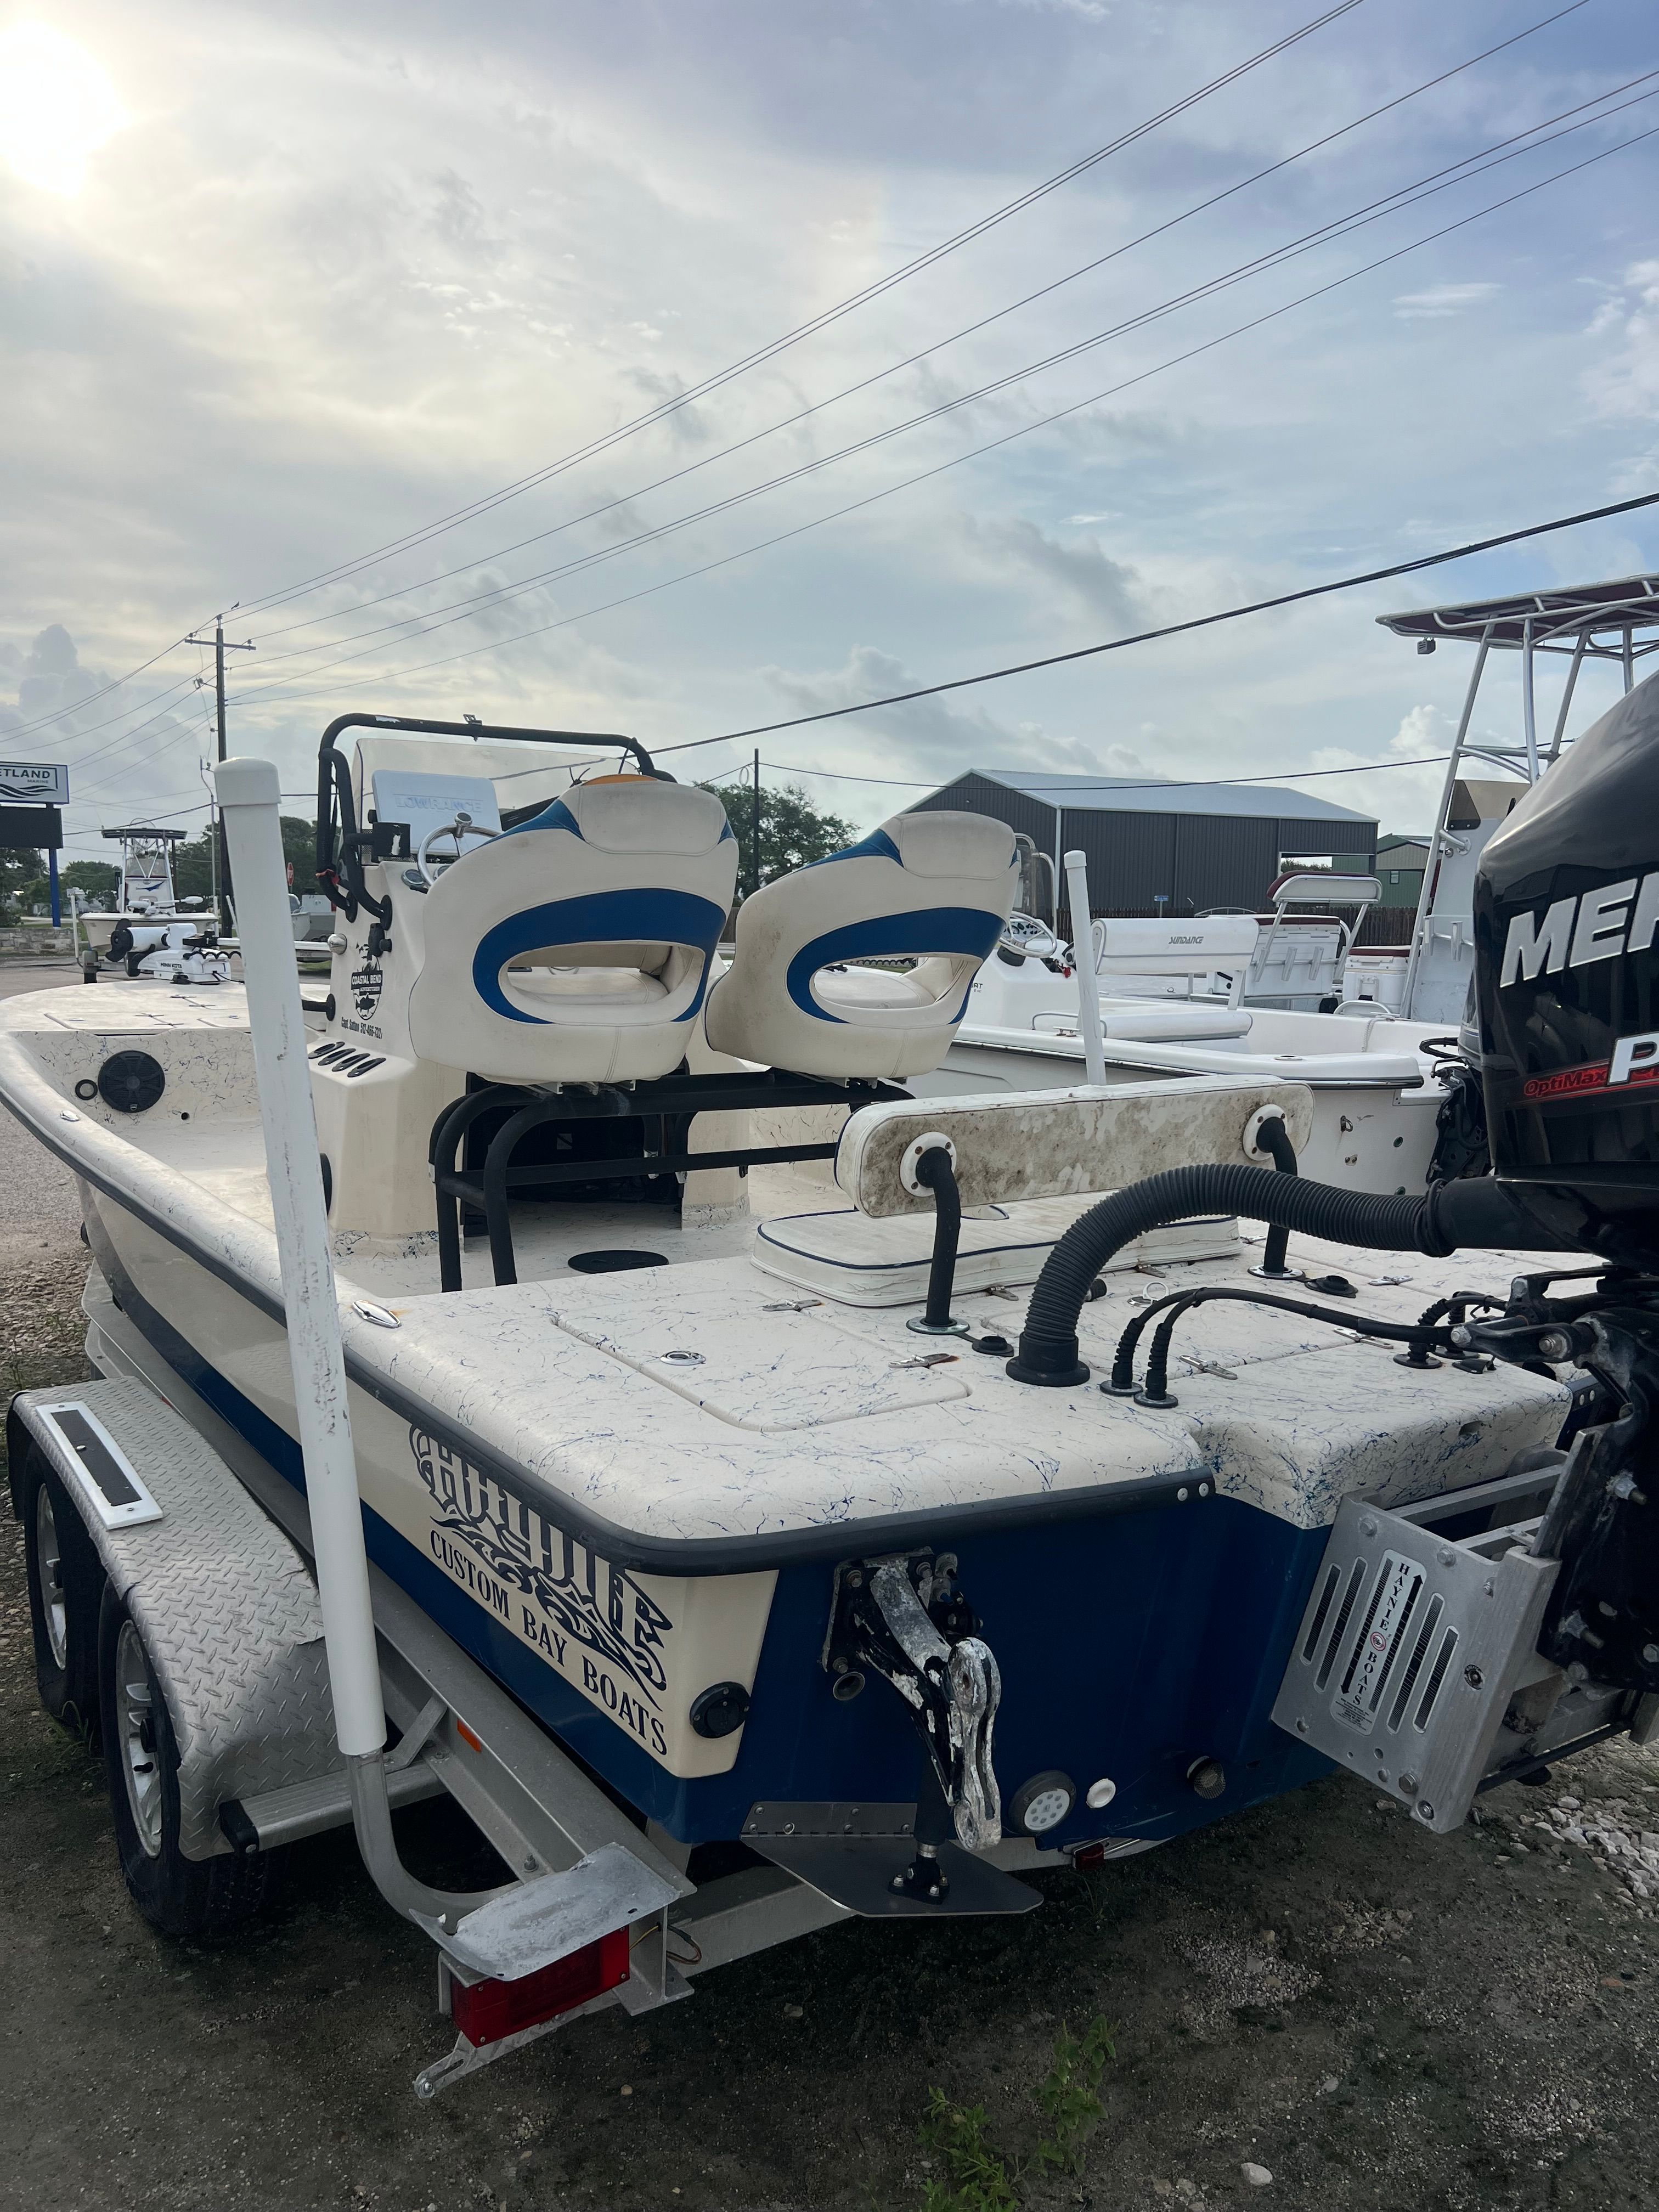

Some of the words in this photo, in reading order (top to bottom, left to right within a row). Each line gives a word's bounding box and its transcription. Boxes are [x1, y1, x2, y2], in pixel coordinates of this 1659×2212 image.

[0, 769, 50, 778] TLAND
[396, 797, 482, 812] LOWRANCE
[1168, 936, 1204, 944] SUNDANCE
[352, 975, 369, 985] COASTAL
[370, 974, 382, 984] BEND
[1524, 1069, 1609, 1097] OptiMax
[1379, 1562, 1410, 1632] HAYNIE
[430, 1530, 511, 1621] CUSTOM
[521, 1604, 568, 1667] BAY
[582, 1654, 667, 1756] BOATS
[1352, 1650, 1378, 1706] BOATS
